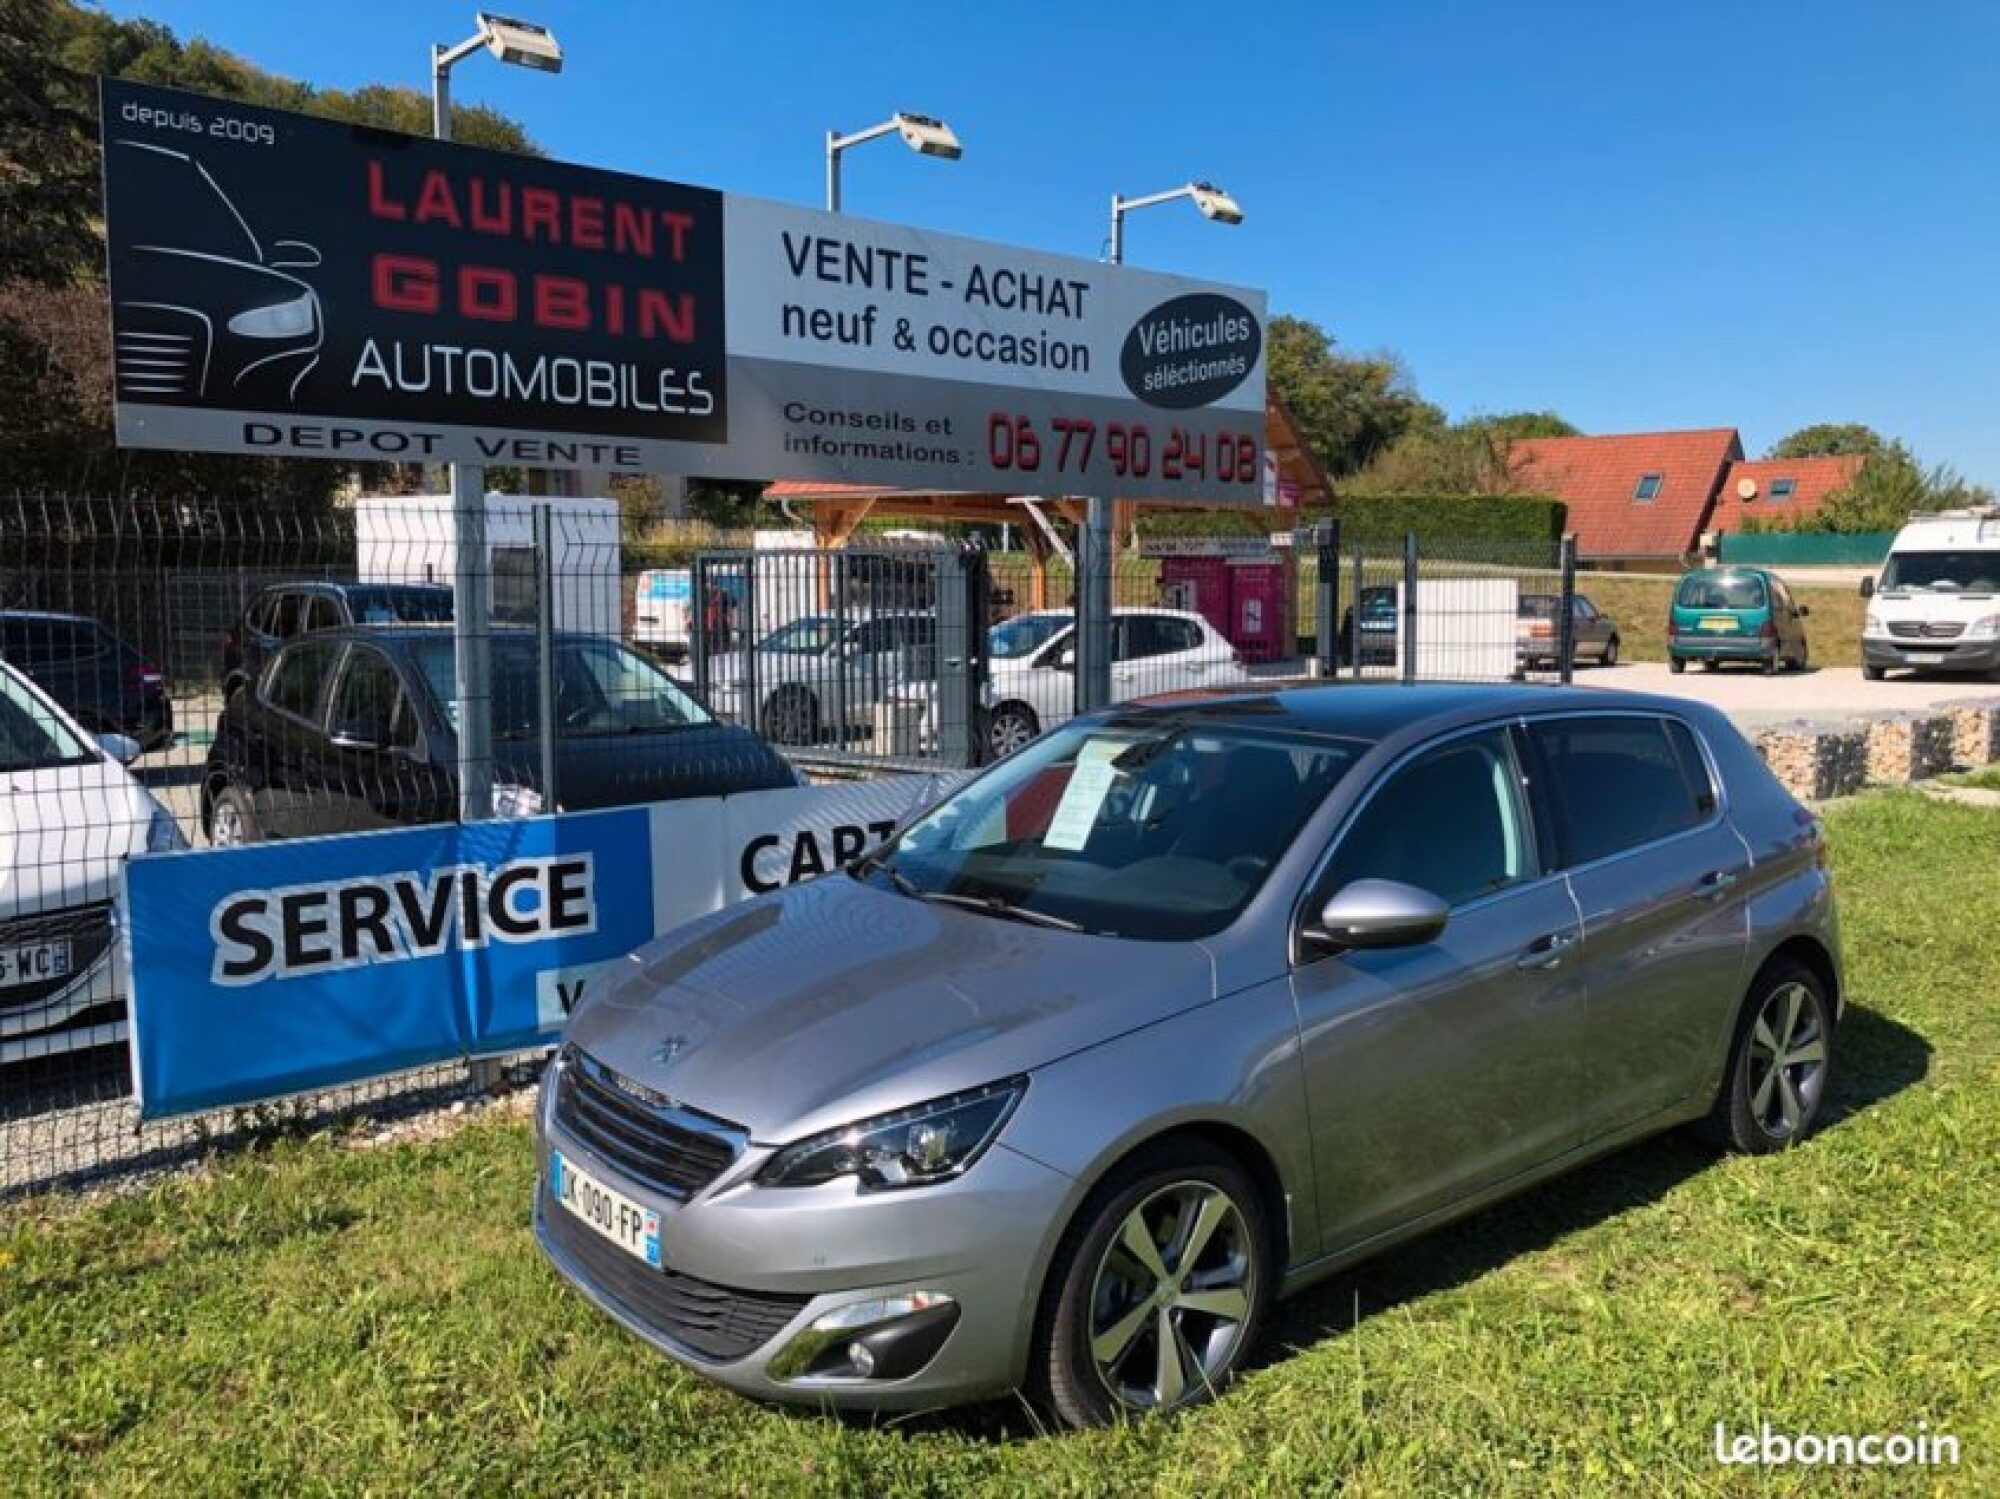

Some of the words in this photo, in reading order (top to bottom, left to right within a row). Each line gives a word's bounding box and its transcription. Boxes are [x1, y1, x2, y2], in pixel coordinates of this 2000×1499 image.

[122, 100, 203, 133] depuis
[209, 117, 275, 145] 2009
[366, 159, 695, 263] LAURENT
[372, 253, 696, 342] GOBIN
[782, 230, 929, 297] VENTE
[965, 263, 1090, 320] ACHAT
[782, 304, 877, 346] neuf
[894, 317, 916, 352] &
[928, 326, 1090, 373] occasion
[1138, 312, 1250, 357] Véhicules
[351, 337, 714, 414] AUTOMOBILES
[243, 422, 444, 455] DEPOT
[474, 435, 643, 466] VENTE
[784, 401, 915, 433] Conseils
[925, 415, 953, 435] et
[784, 432, 960, 465] informations
[988, 413, 1041, 471] 06
[1050, 418, 1097, 473] 77
[1105, 422, 1150, 478] 90
[1161, 424, 1206, 481] 24
[1216, 429, 1257, 484] 08
[219, 860, 590, 978] SERVICE
